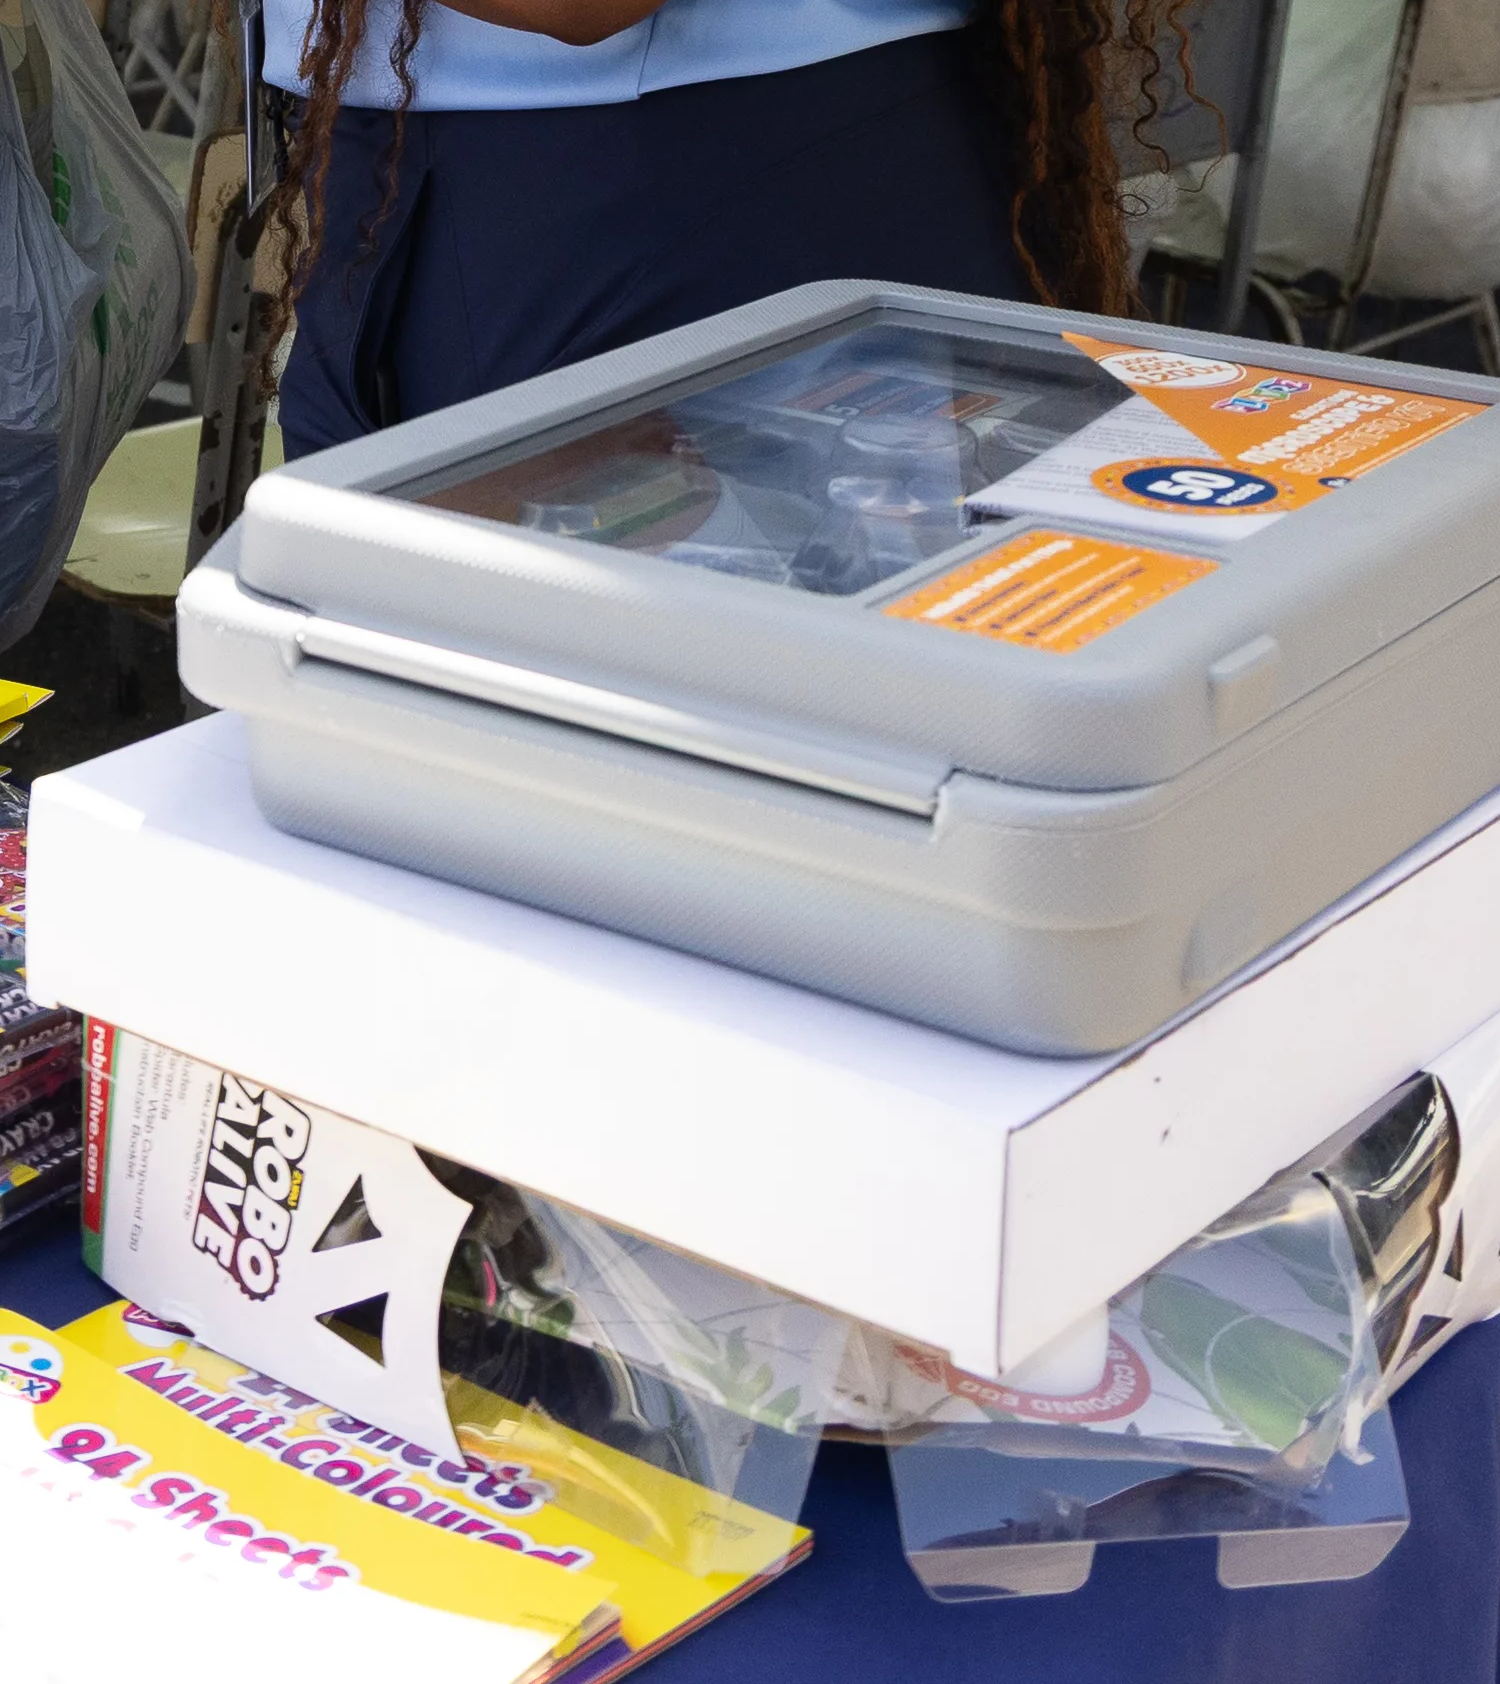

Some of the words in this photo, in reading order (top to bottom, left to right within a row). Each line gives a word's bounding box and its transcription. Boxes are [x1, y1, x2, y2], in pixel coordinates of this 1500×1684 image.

[1147, 470, 1236, 502] 50
[132, 1041, 152, 1120] nstruction
[192, 1073, 261, 1270] ALIVE
[235, 1090, 312, 1303] ROBO
[124, 1358, 585, 1573] Multi-Coloured
[130, 1475, 353, 1593] Sheets
